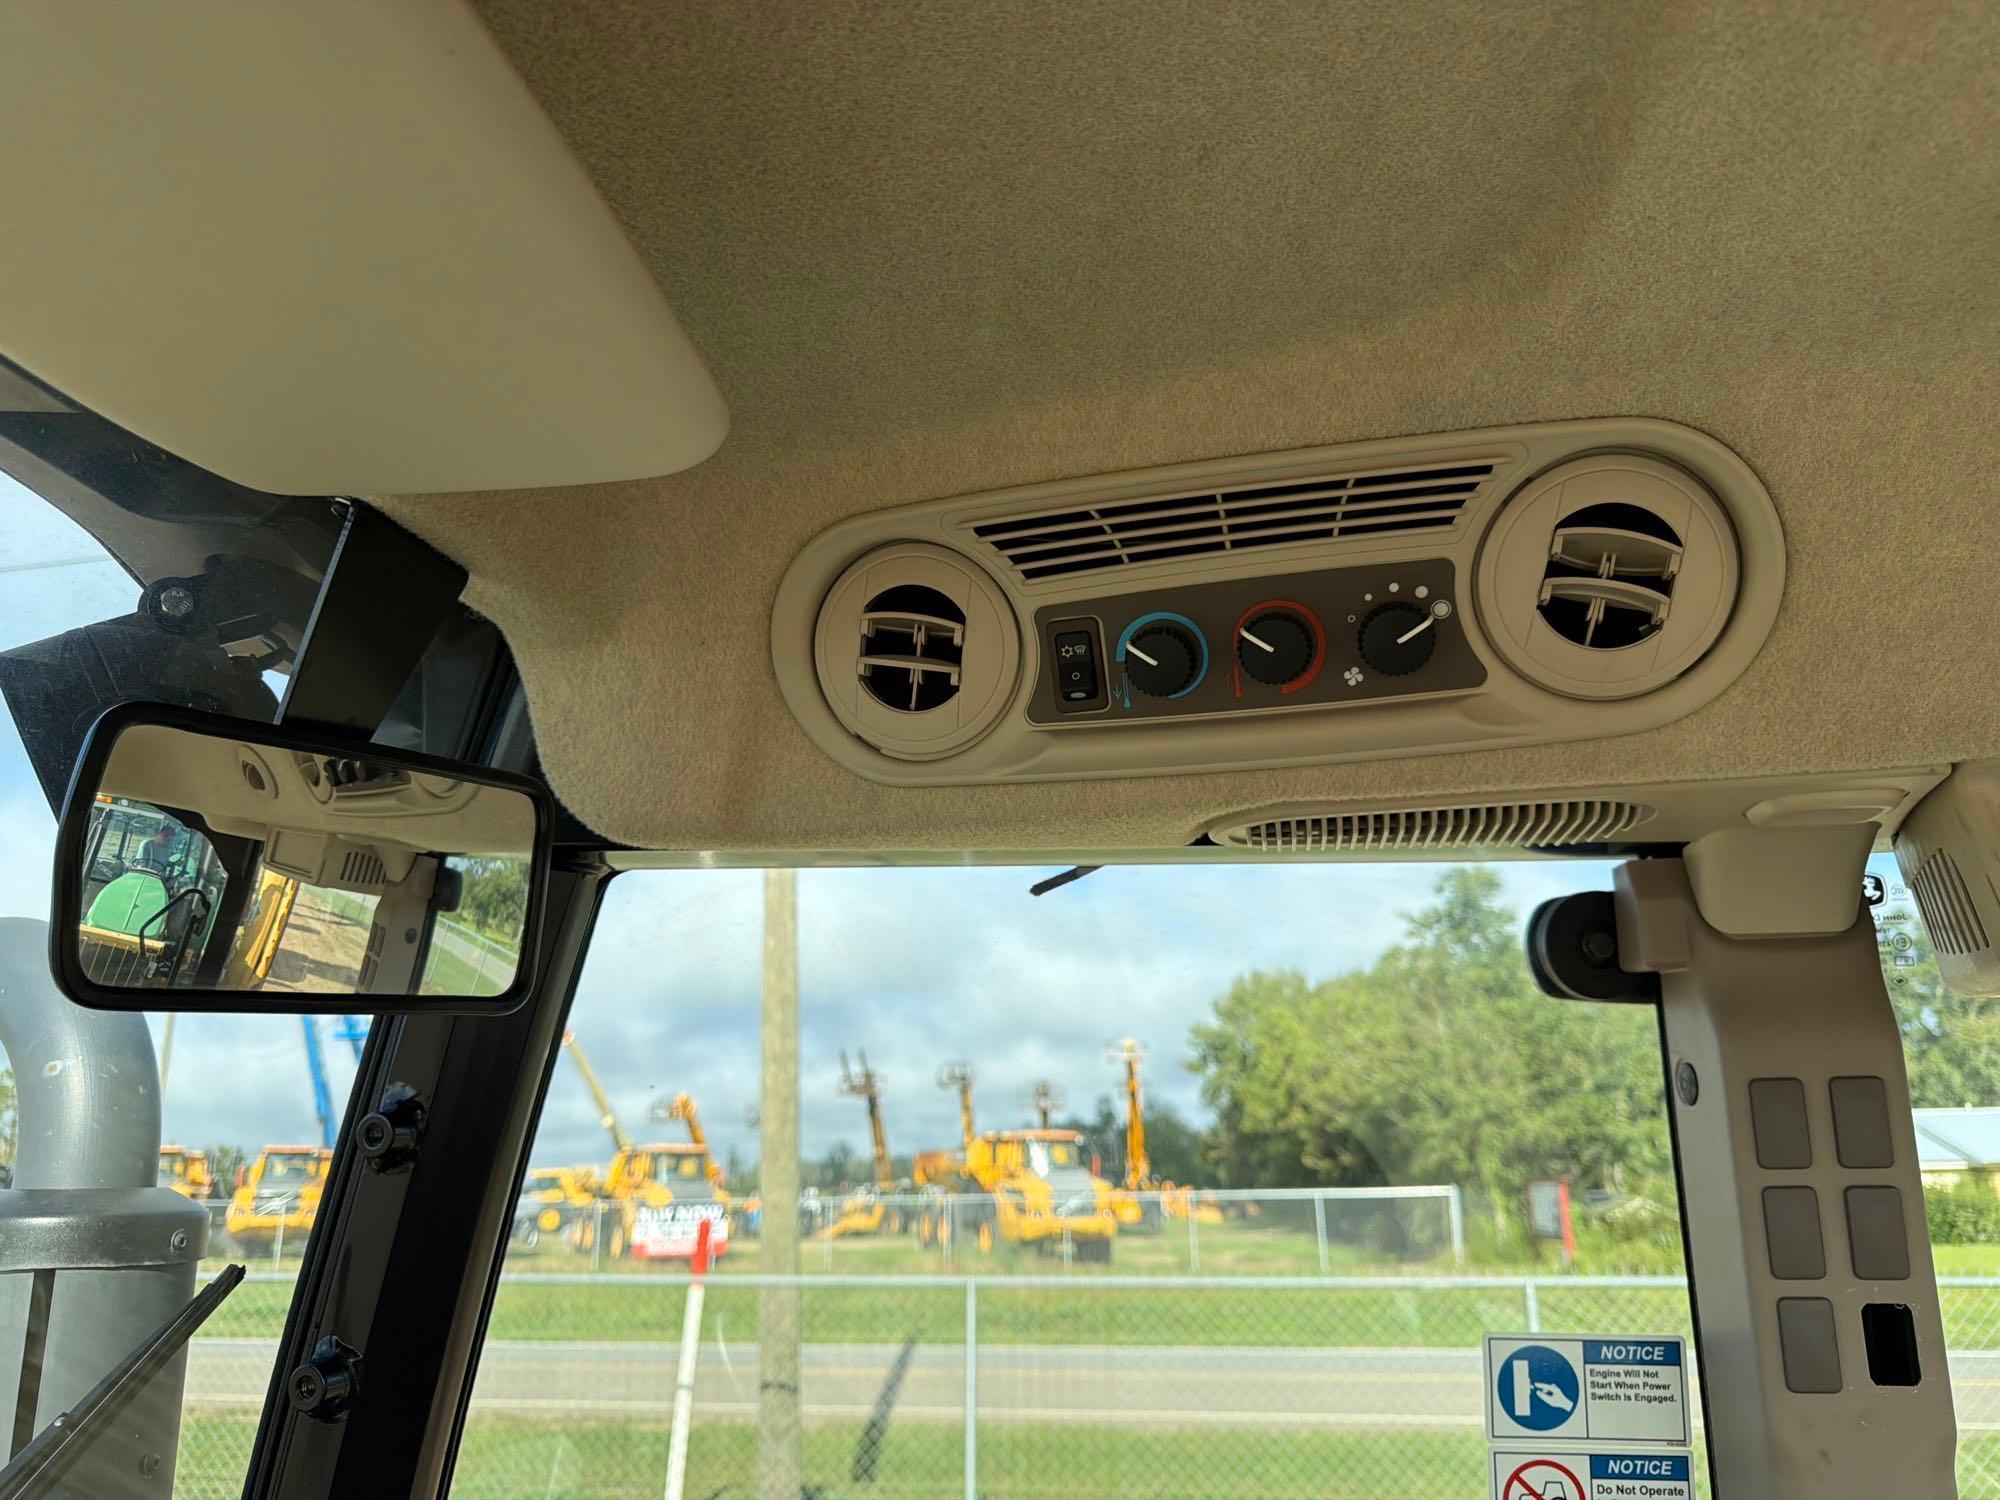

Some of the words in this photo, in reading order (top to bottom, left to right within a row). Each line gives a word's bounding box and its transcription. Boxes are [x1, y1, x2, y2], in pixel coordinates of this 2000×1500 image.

[1601, 1346, 1664, 1361] NOTICE
[1590, 1369, 1621, 1379] Engine
[1623, 1370, 1641, 1378] Will
[1643, 1371, 1659, 1379] Not
[1590, 1381, 1612, 1390] Start
[1614, 1382, 1640, 1390] When
[1643, 1382, 1671, 1391] Power
[1591, 1393, 1621, 1401] Switch
[1634, 1394, 1676, 1404] Engaged.
[1608, 1460, 1671, 1475] NOTICE
[1597, 1485, 1612, 1494] Do
[1617, 1485, 1636, 1495] Not
[1640, 1486, 1684, 1497] Operate
